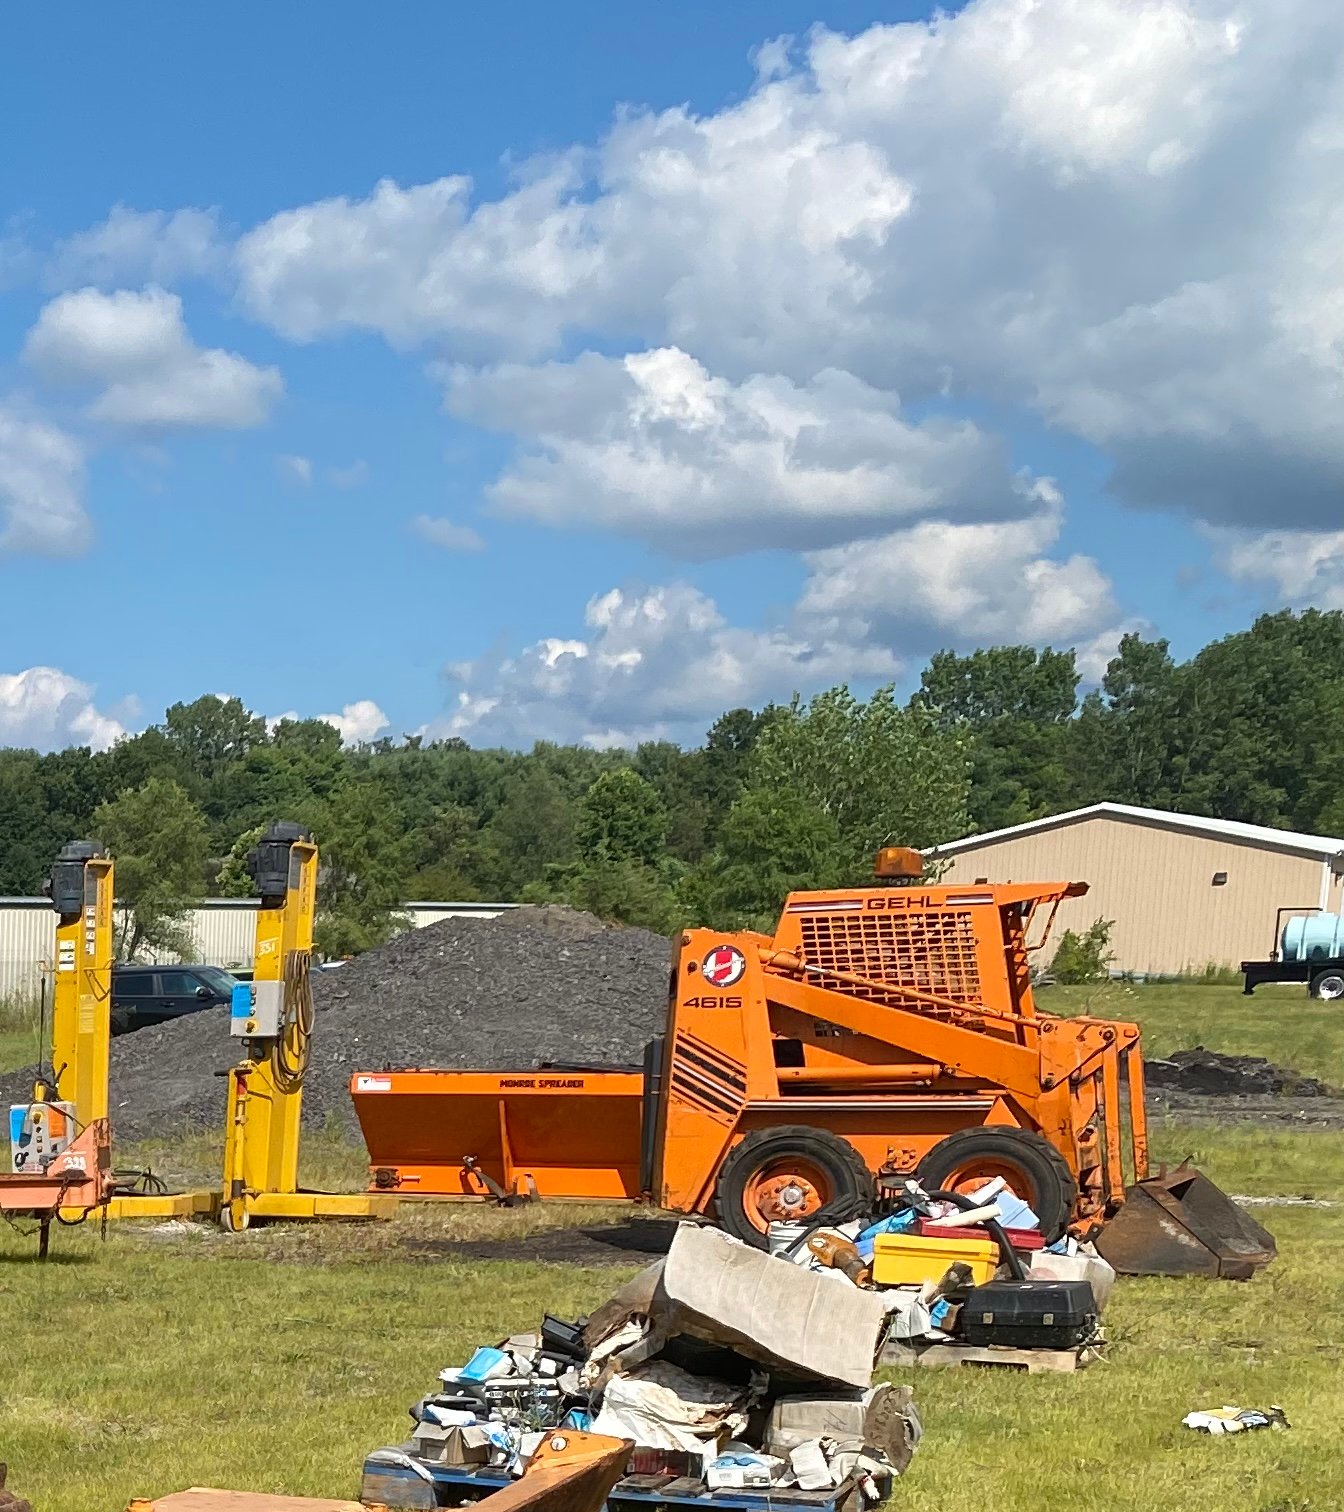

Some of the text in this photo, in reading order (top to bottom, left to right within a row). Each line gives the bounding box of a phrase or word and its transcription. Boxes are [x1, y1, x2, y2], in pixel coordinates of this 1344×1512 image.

[867, 895, 943, 910] GEHL
[683, 996, 742, 1009] 4615
[499, 1079, 584, 1088] MONROE SPREADER
